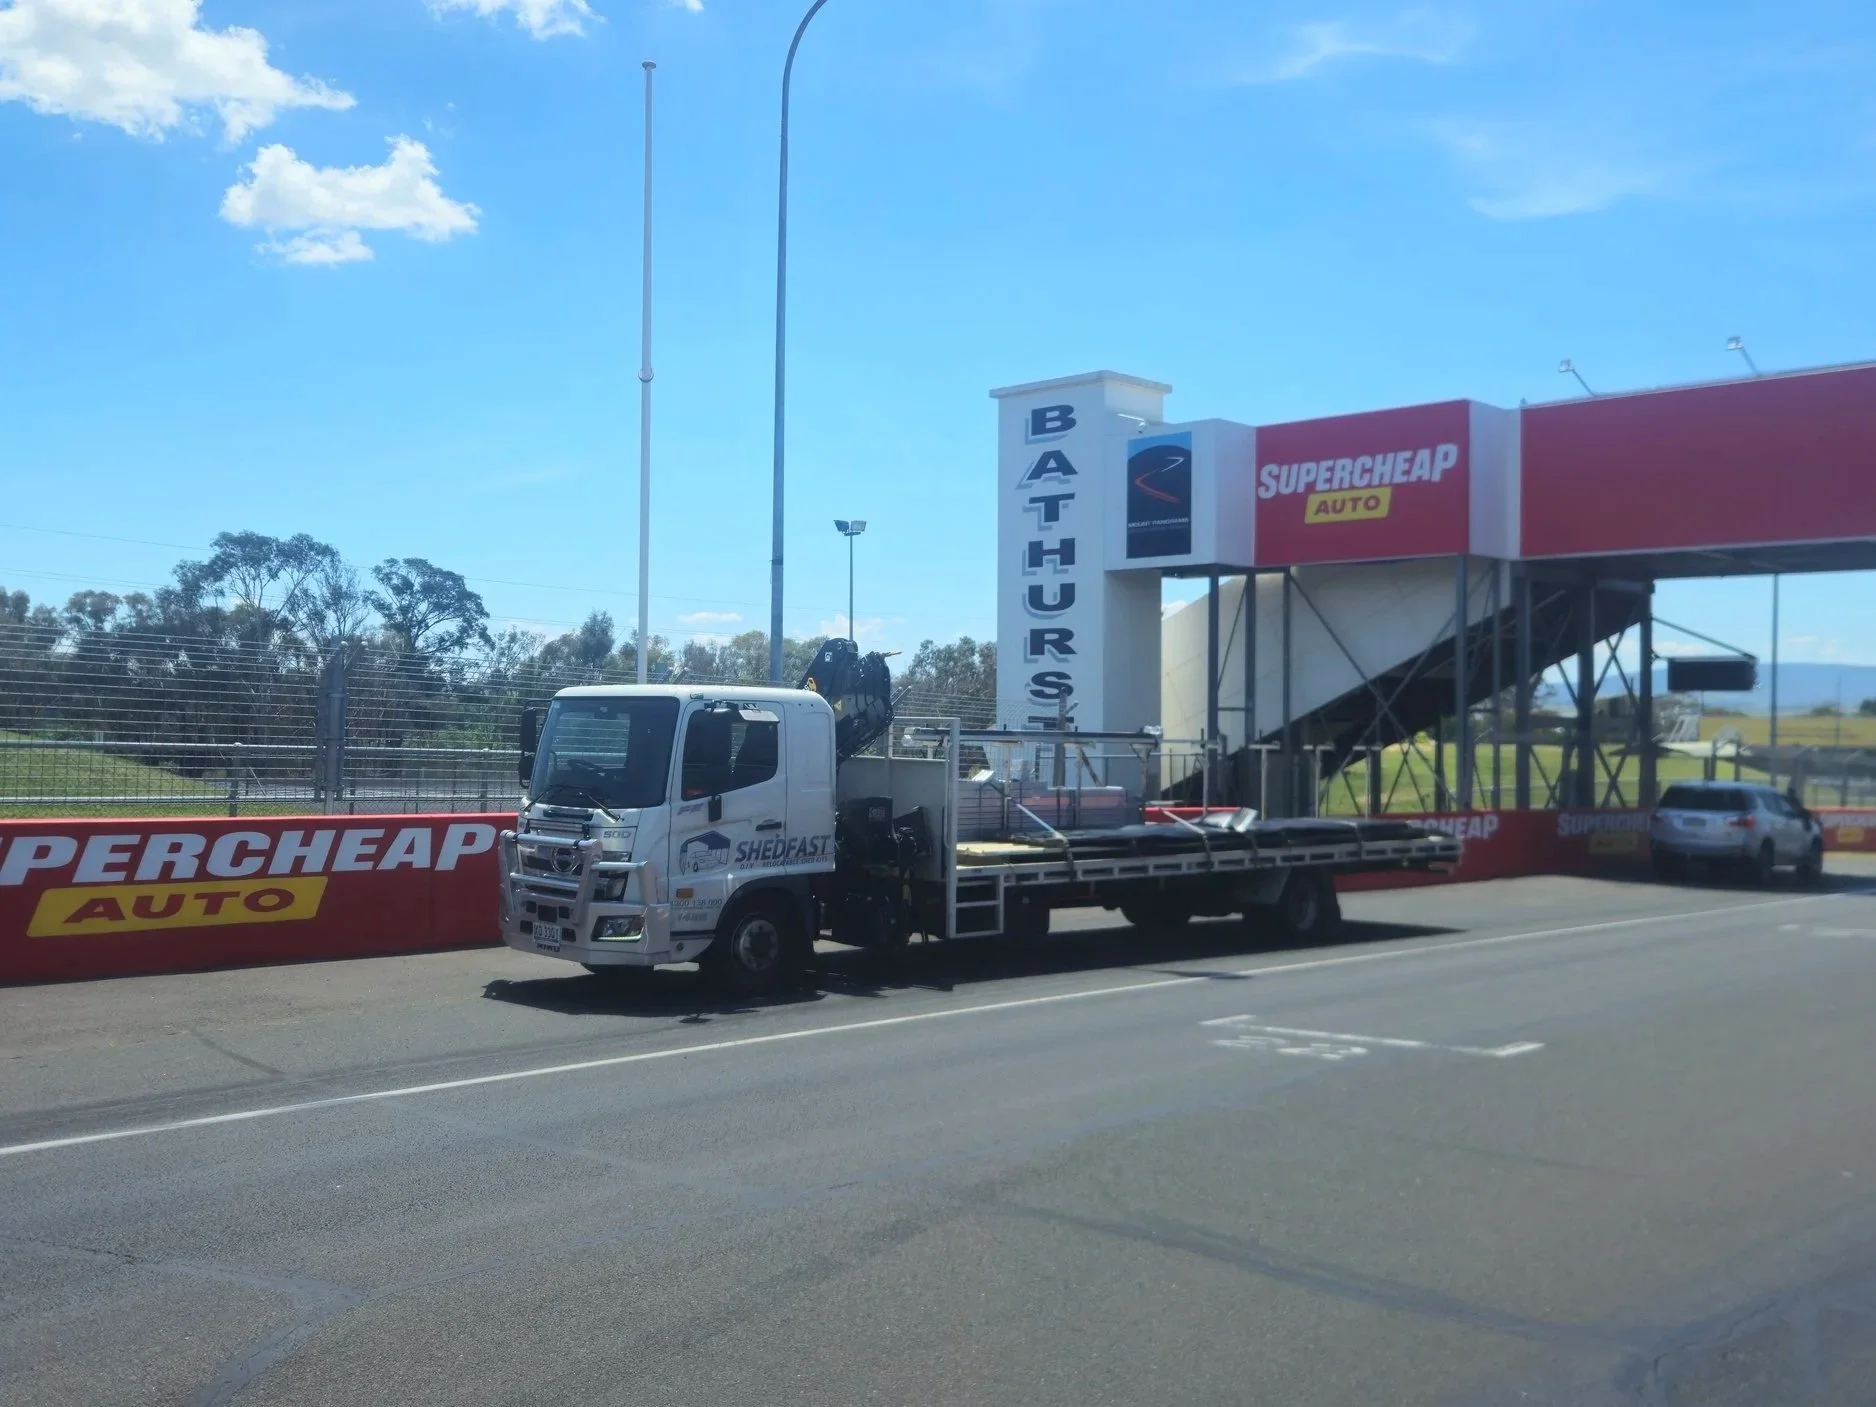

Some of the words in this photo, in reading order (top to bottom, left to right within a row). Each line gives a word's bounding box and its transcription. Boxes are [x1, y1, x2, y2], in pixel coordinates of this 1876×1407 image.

[1257, 443, 1459, 500] SUPERCHEAP
[1313, 494, 1381, 517] AUTO
[0, 823, 497, 886] PERCHEAP
[734, 834, 832, 863] SHEDFAST
[62, 887, 295, 924] AUTO
